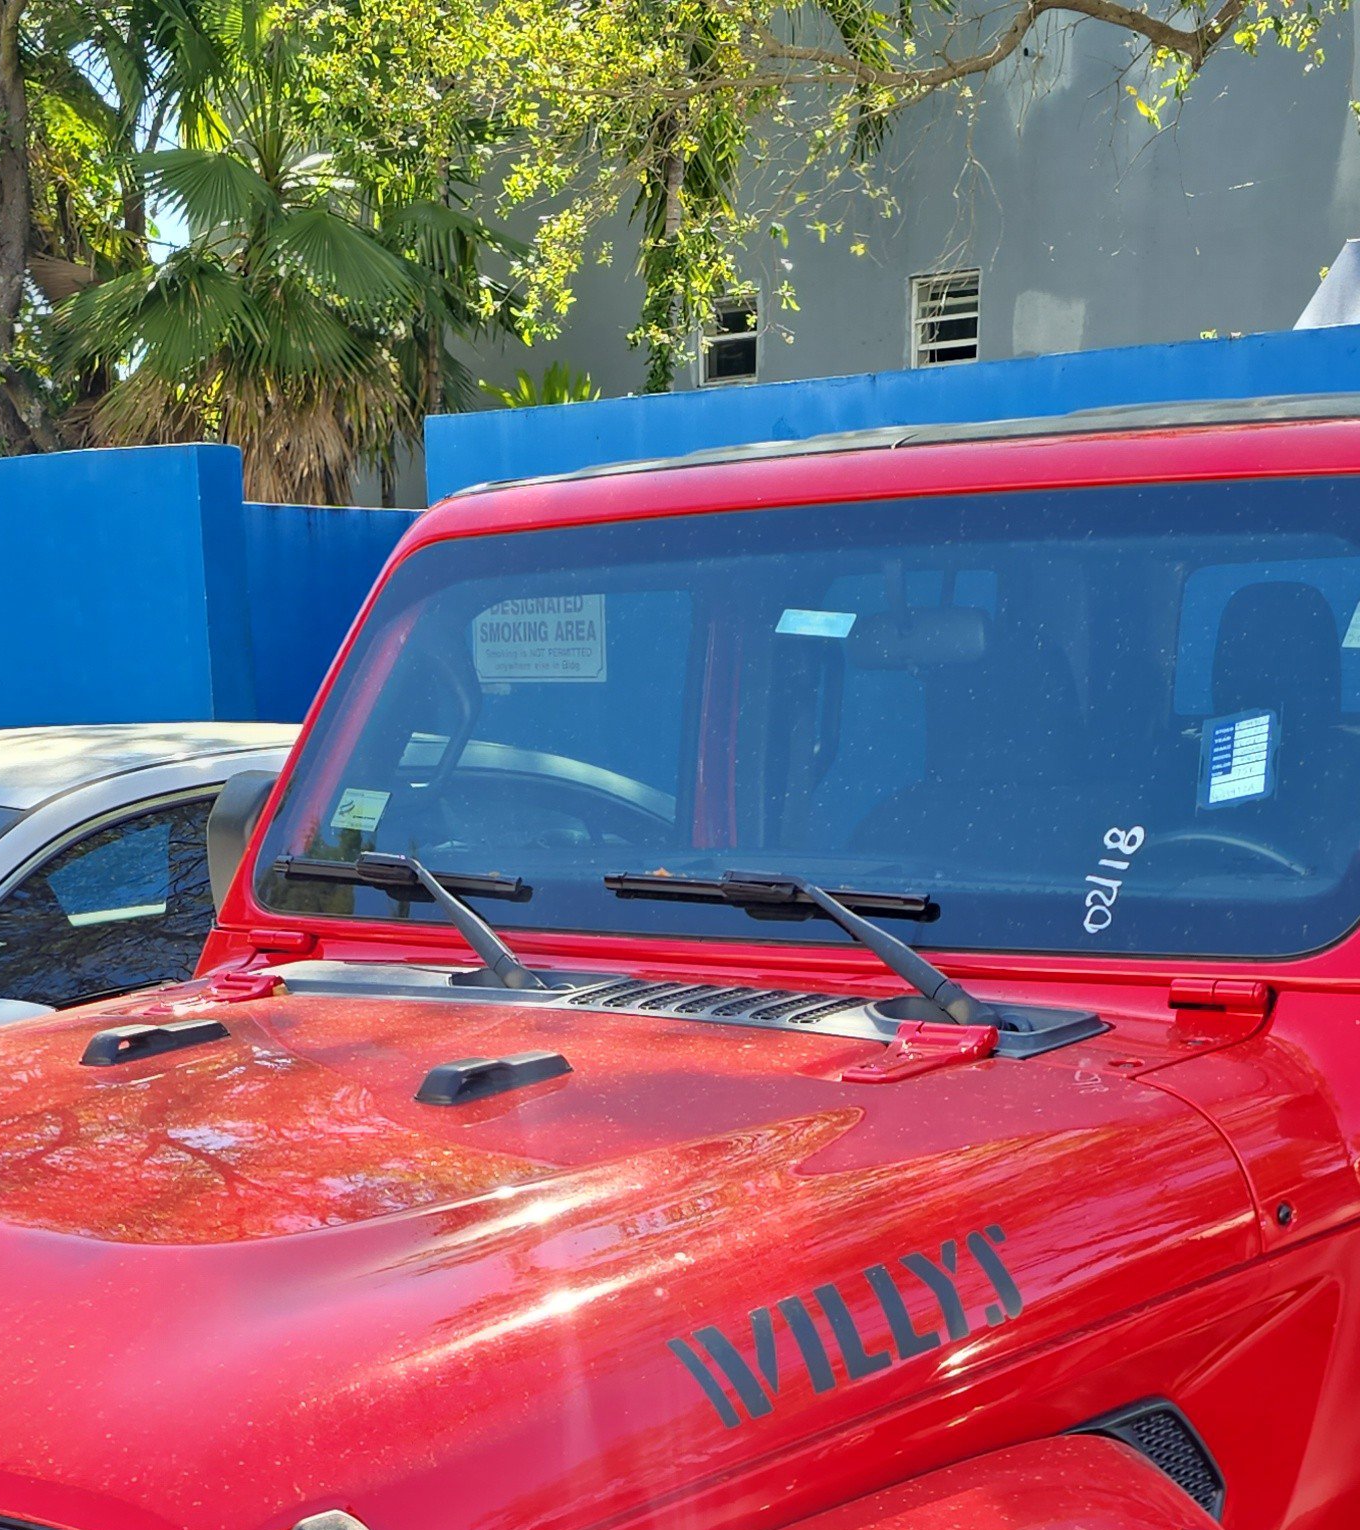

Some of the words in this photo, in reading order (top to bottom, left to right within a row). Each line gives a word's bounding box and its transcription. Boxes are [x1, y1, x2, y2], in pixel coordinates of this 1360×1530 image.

[480, 621, 548, 643] SMOKING
[555, 620, 597, 642] AREA
[666, 1224, 1023, 1429] WILLYS
